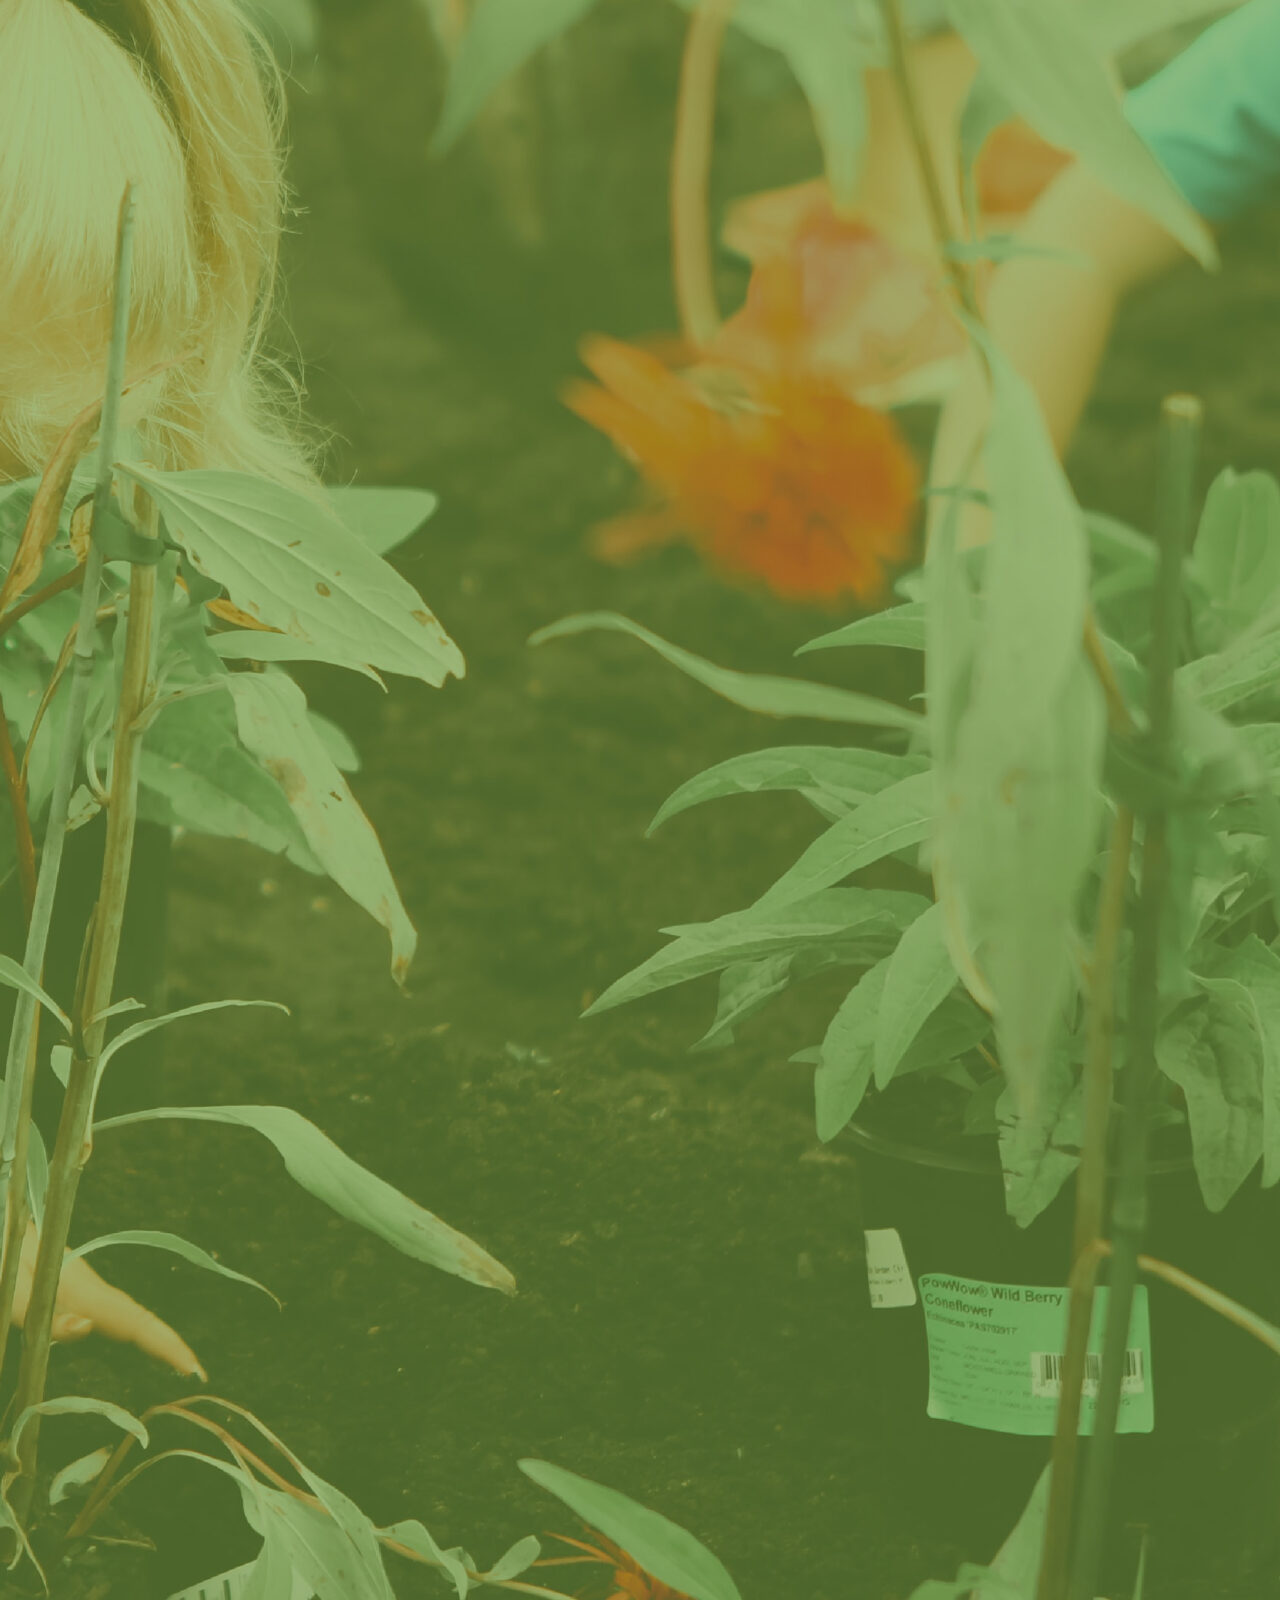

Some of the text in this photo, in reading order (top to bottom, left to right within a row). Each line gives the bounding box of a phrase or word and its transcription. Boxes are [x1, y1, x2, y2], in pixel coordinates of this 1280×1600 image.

[924, 1293, 993, 1317] Coneflower
[991, 1287, 1020, 1301] Wild
[1024, 1290, 1063, 1306] Berry
